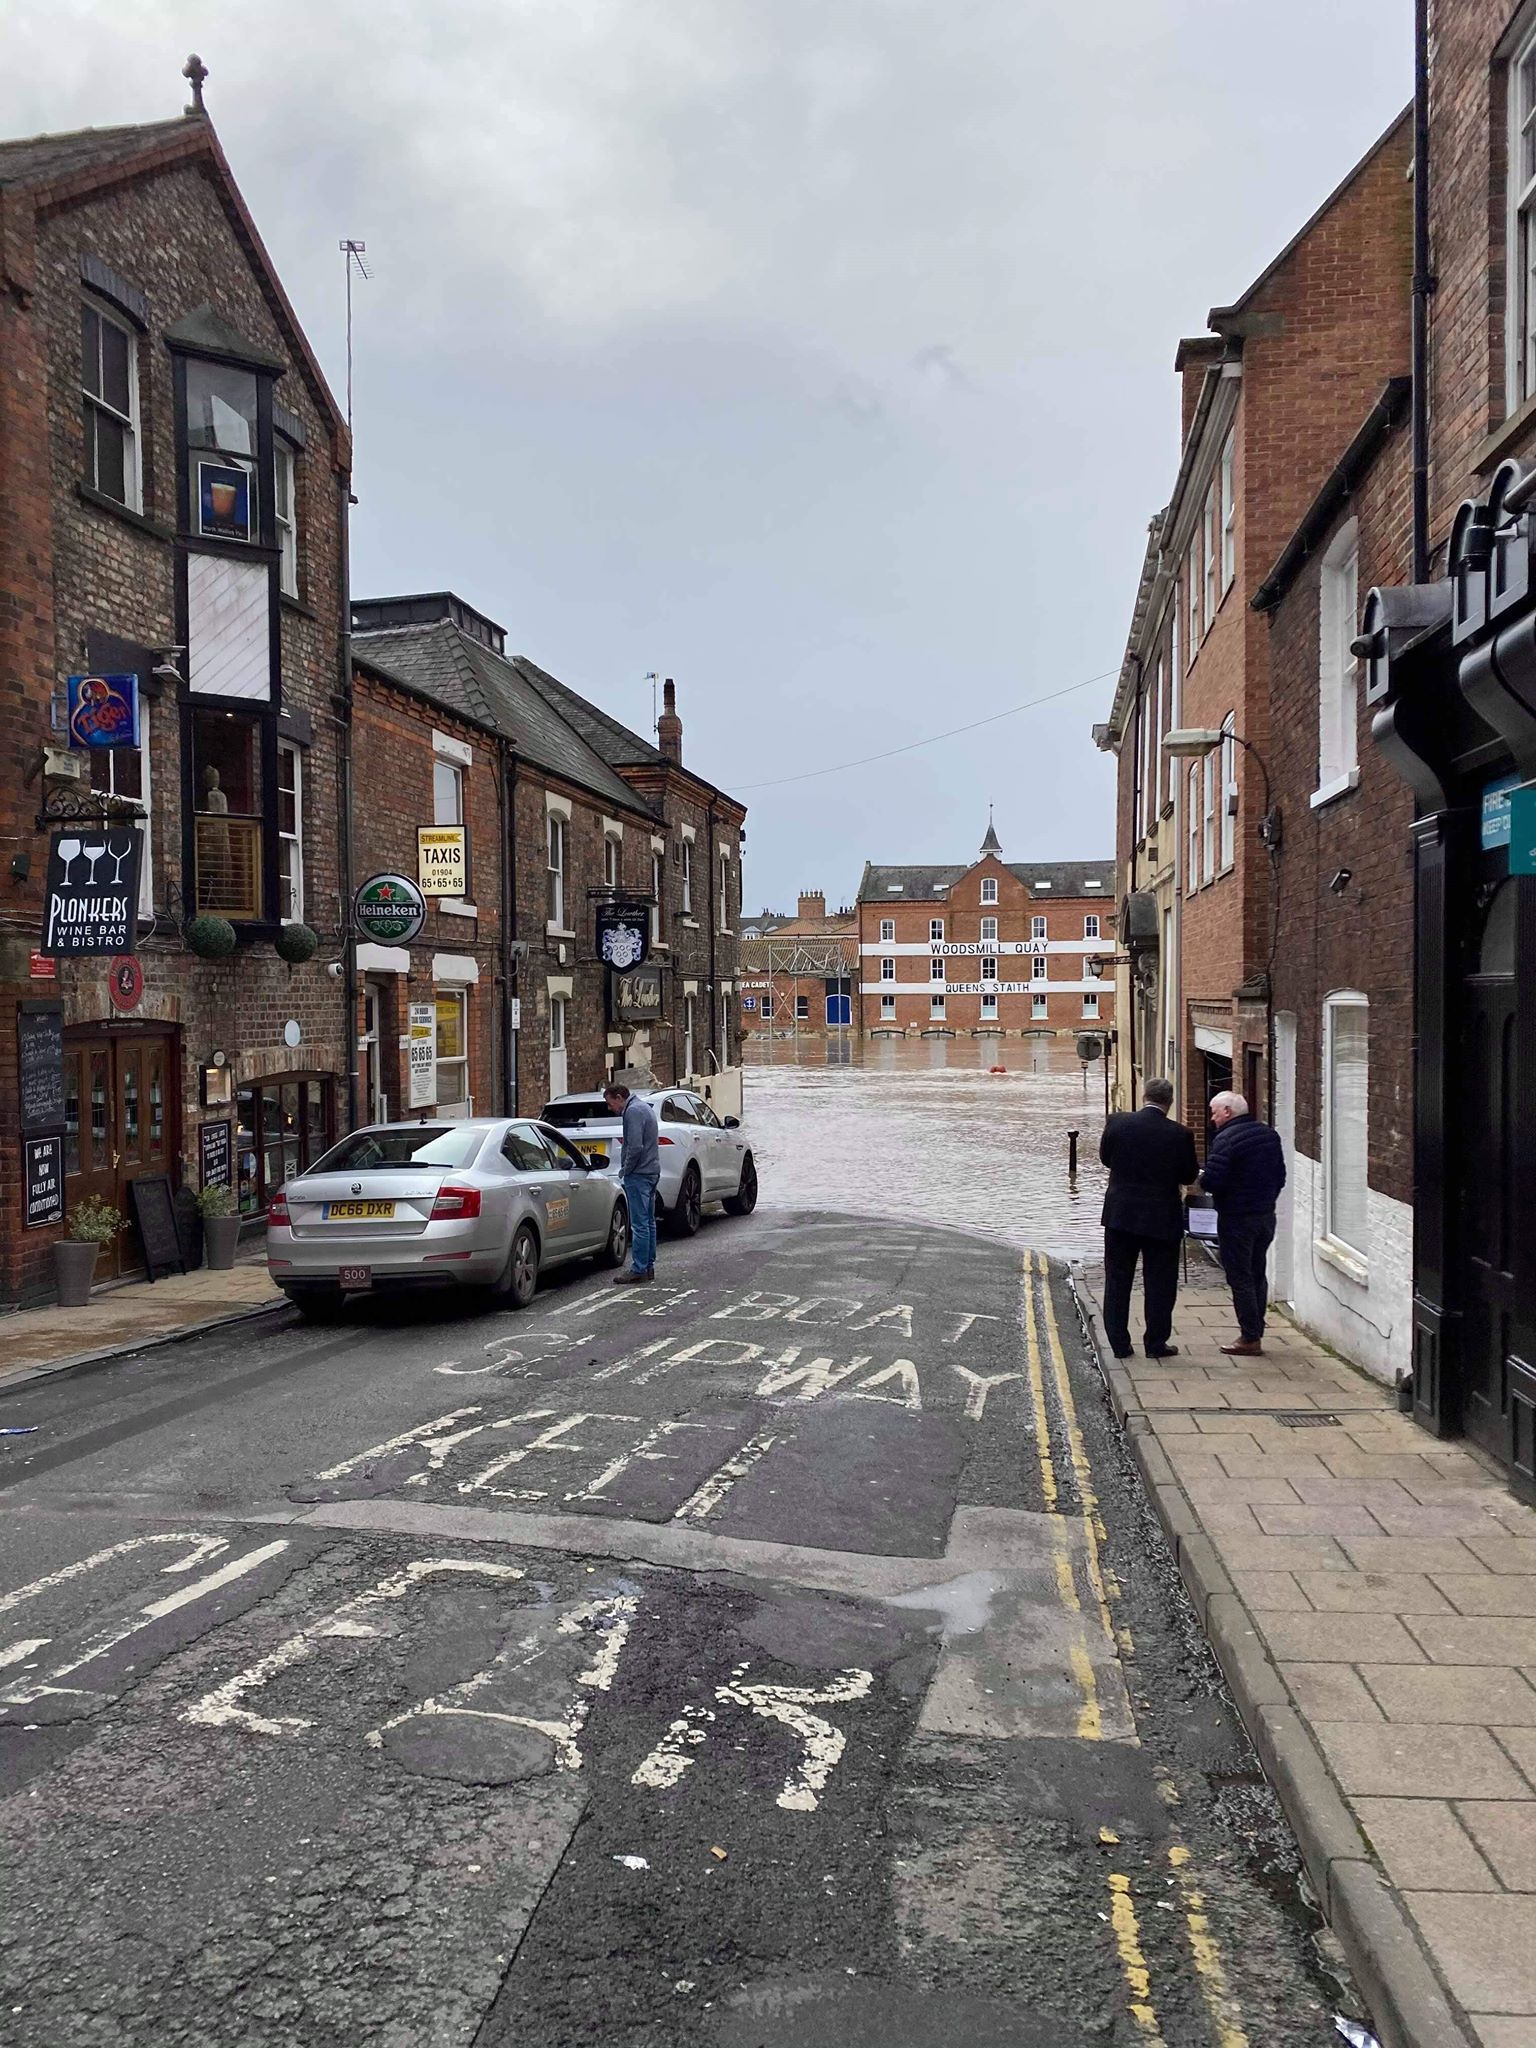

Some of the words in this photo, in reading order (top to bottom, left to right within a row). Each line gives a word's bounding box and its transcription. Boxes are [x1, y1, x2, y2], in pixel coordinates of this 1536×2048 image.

[78, 703, 126, 734] Tiger
[423, 848, 460, 864] TAXIS
[359, 905, 417, 916] Heineken
[601, 907, 615, 916] The
[48, 893, 128, 947] PLONKERS
[57, 925, 92, 936] WINE
[99, 925, 127, 935] BAR
[57, 937, 65, 947] &
[72, 936, 124, 946] BISTRO
[931, 944, 1005, 954] WOODSMILL
[1015, 943, 1049, 954] QUAY
[945, 983, 986, 993] QUEENS
[993, 983, 1030, 992] STAITH
[32, 1180, 47, 1196] FULLY
[330, 1203, 364, 1216] DC66
[367, 1202, 393, 1215] DXR
[344, 1269, 366, 1280] 500
